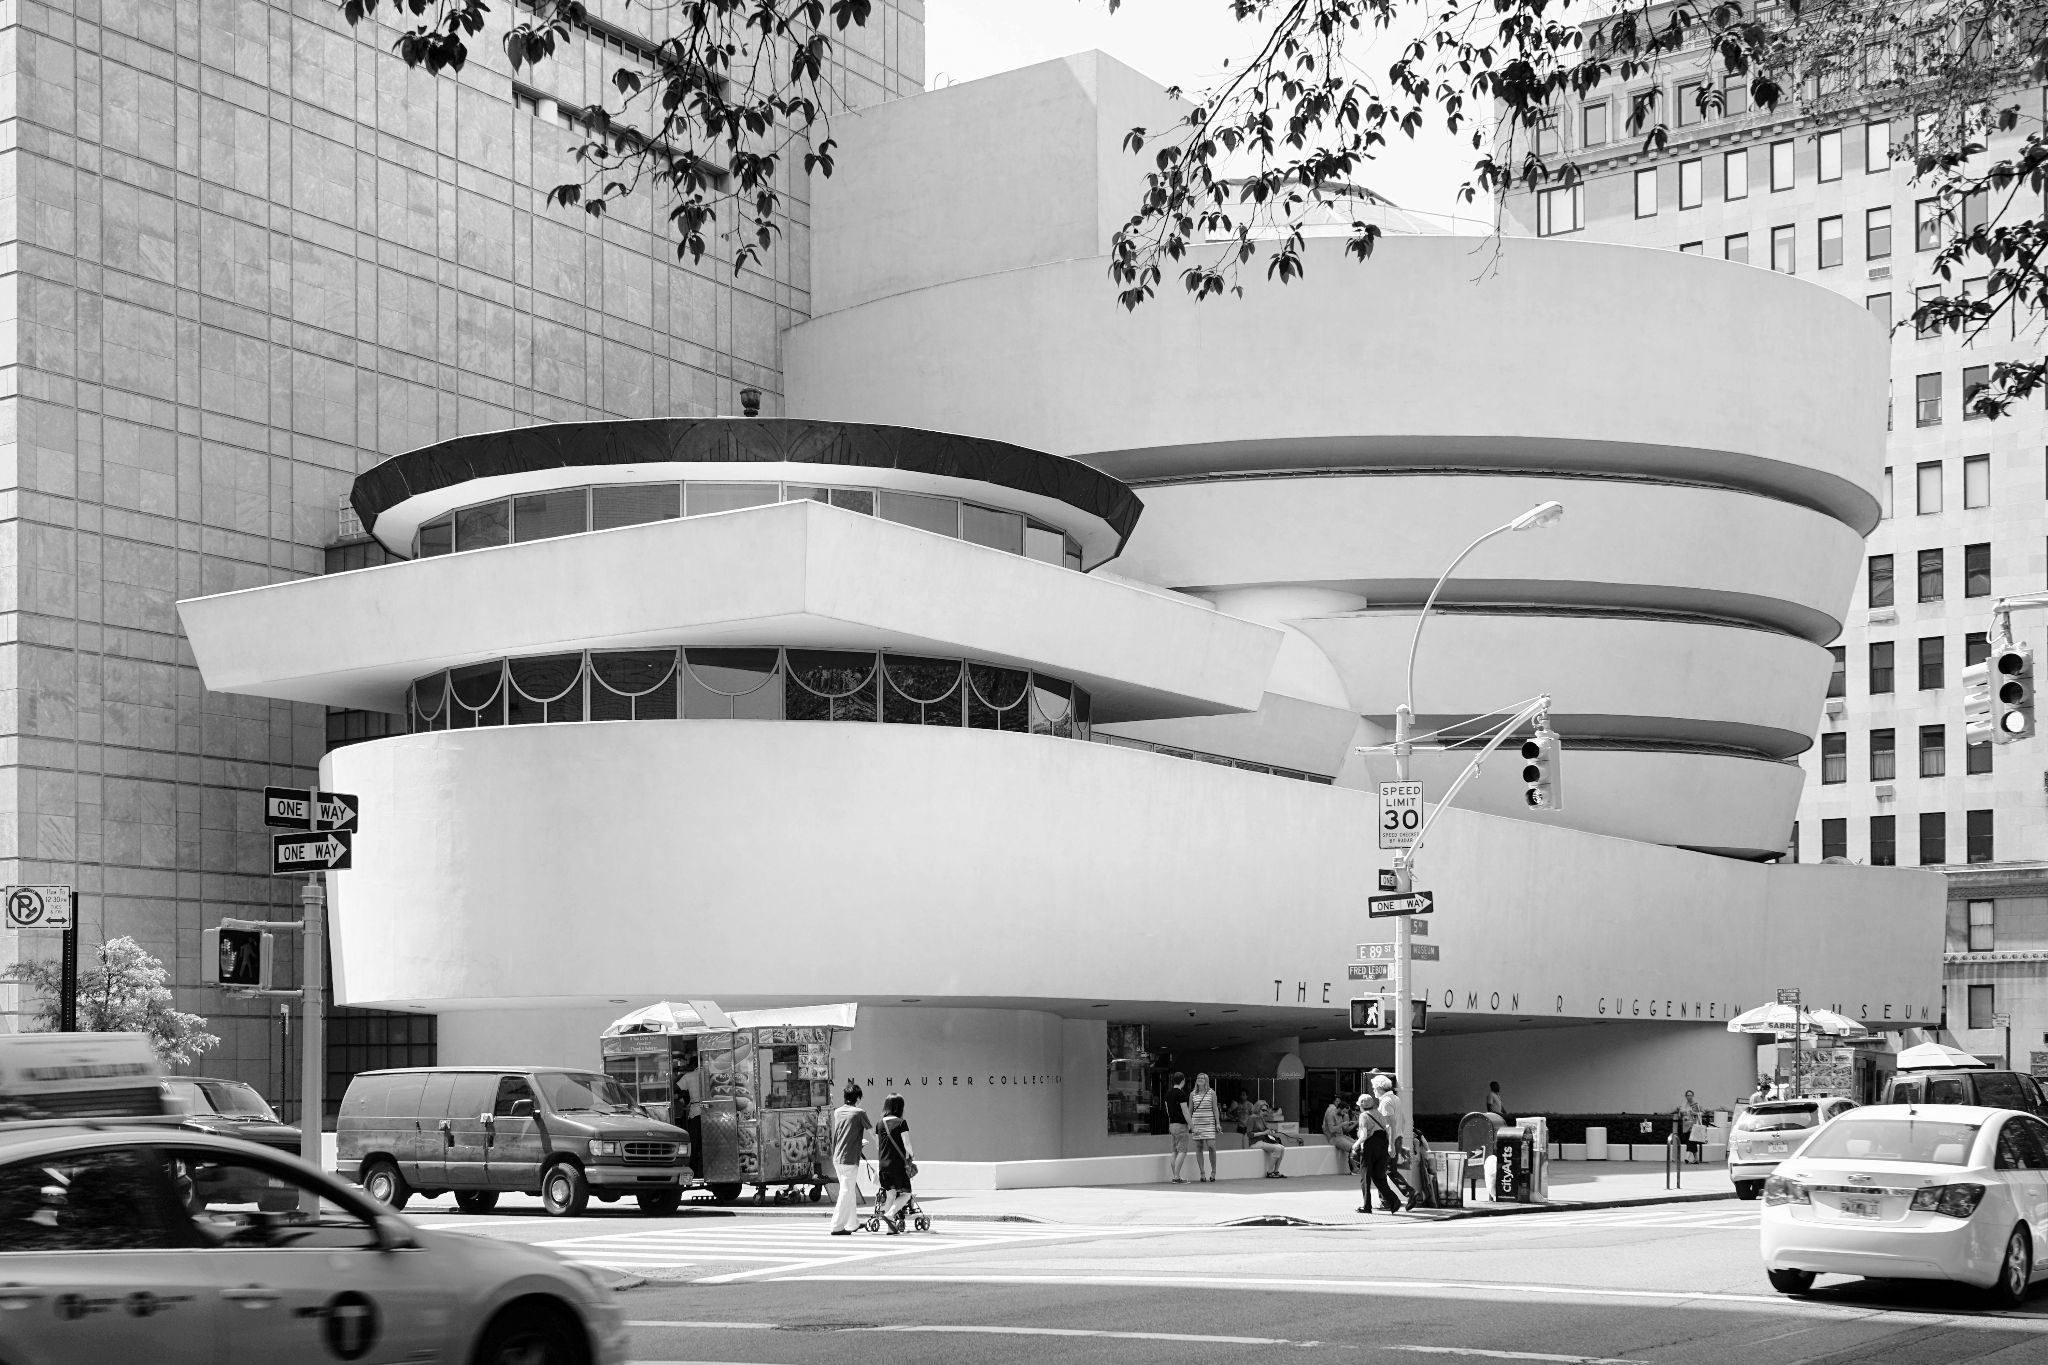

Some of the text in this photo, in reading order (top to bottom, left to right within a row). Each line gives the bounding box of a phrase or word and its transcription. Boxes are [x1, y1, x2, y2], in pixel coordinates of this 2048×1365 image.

[1382, 786, 1421, 796] SPEED
[1386, 797, 1416, 807] LIMIT
[278, 800, 347, 821] ONE WAY
[1383, 809, 1419, 830] 30
[283, 843, 339, 861] ONE WAY
[1382, 875, 1393, 885] ONE
[1377, 898, 1425, 911] ONE WAY
[1413, 920, 1418, 934] 5
[1360, 945, 1392, 959] E 89 ST
[1413, 945, 1435, 955] MUSEUM
[1349, 966, 1367, 975] FRED
[1368, 965, 1387, 975] LEBOW
[1274, 980, 1331, 1003] THE
[1556, 995, 1564, 1014] R
[1598, 997, 1743, 1019] GUGGENHEIM
[1768, 1022, 1807, 1030] SABRET
[828, 1076, 974, 1087] ANNHAUSER
[1501, 1145, 1514, 1193] cityArts
